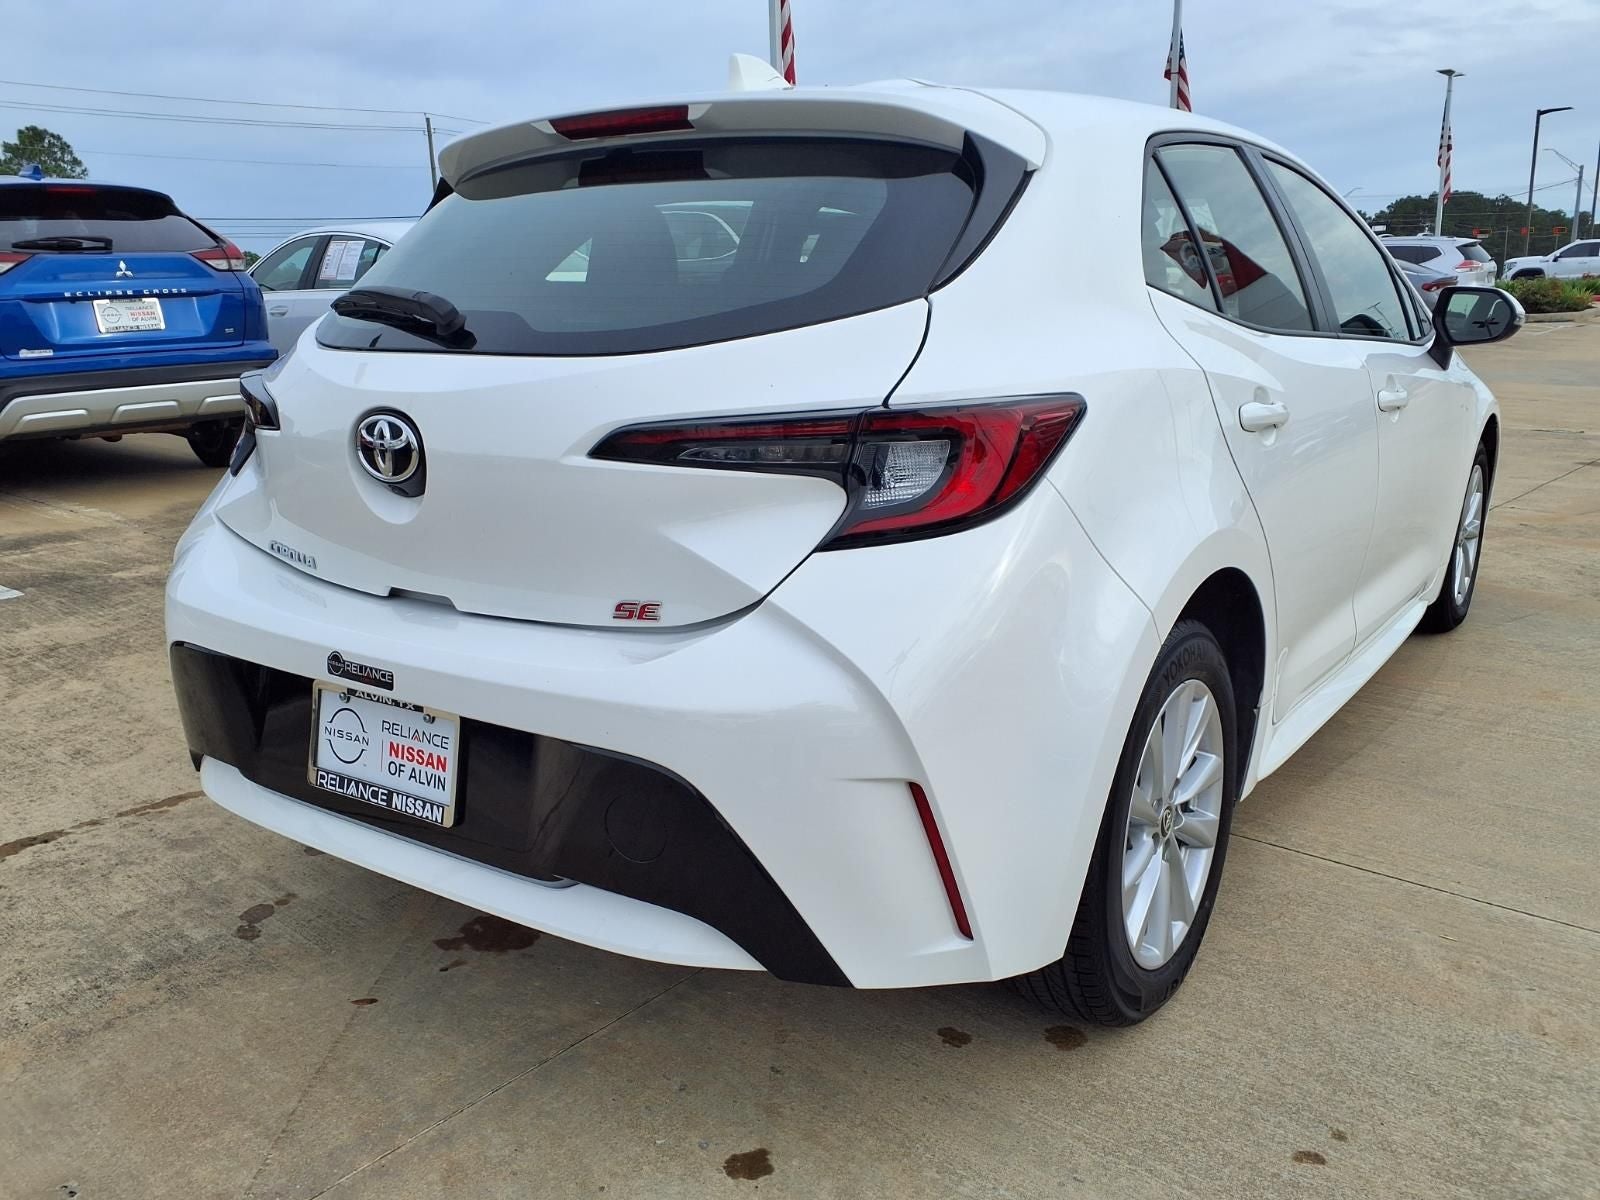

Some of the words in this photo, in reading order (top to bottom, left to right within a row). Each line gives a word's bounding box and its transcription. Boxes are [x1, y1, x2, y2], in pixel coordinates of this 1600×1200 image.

[612, 600, 661, 621] SE
[344, 662, 393, 683] RELIANCE
[399, 700, 416, 710] TX
[324, 726, 370, 746] NISSAN
[382, 720, 449, 750] RELIANCE
[389, 741, 447, 772] NISSAN
[388, 761, 406, 778] OF
[408, 766, 446, 792] ALVIN
[317, 771, 388, 806] RELIANCE
[392, 793, 443, 823] NISSAN
